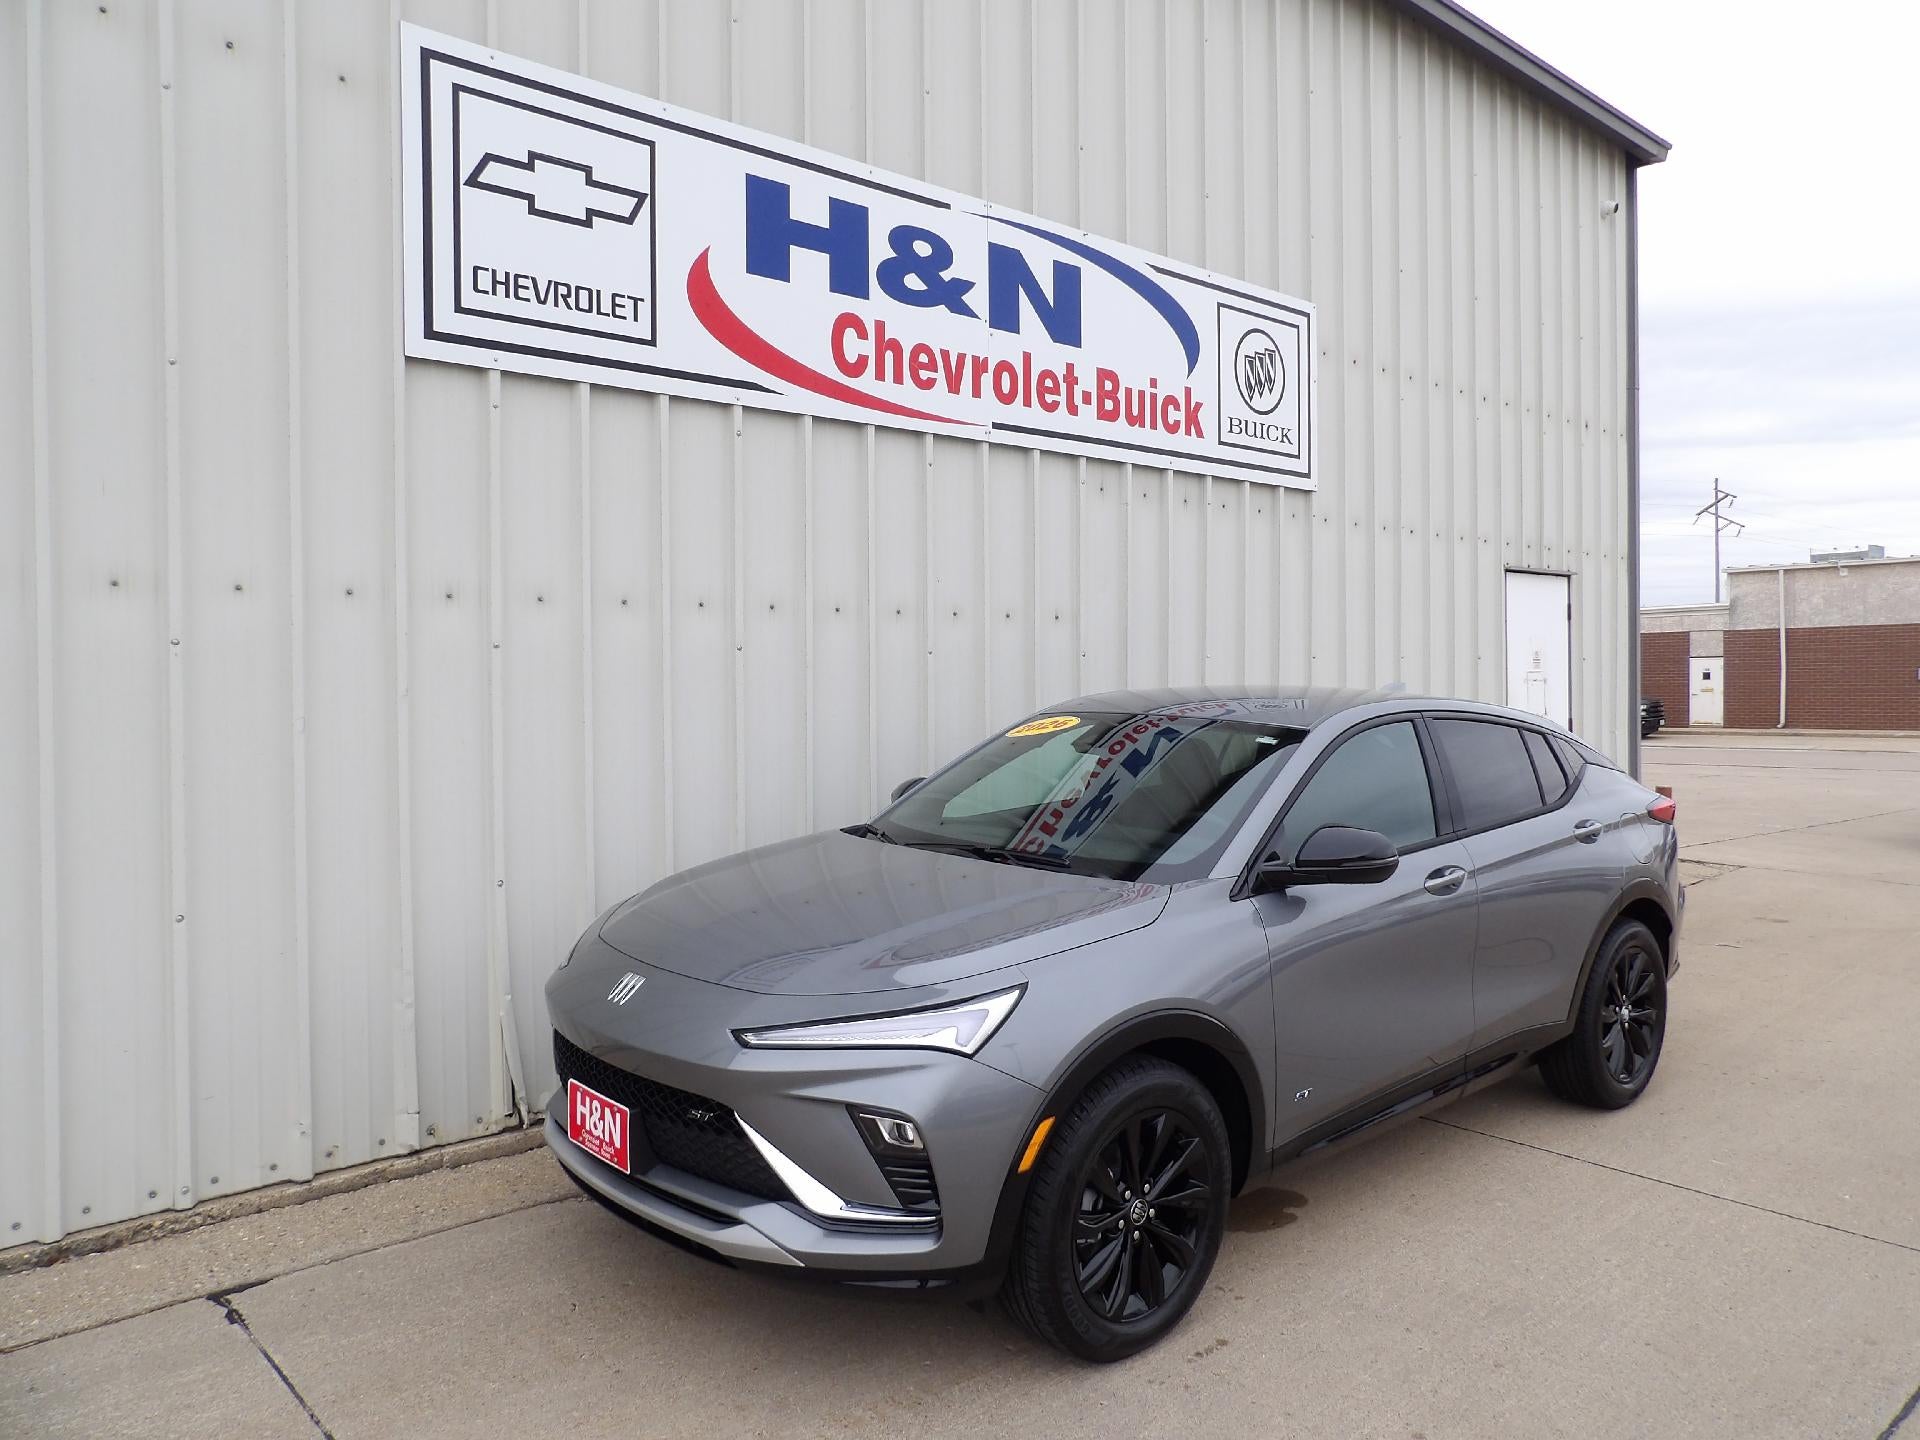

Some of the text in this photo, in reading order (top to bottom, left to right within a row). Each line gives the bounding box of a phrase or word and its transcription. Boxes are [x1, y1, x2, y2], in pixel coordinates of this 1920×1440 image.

[746, 174, 1081, 347] H&N
[472, 265, 645, 323] CHEVROLET
[831, 311, 1204, 439] Chevrolet-Buick
[1227, 416, 1294, 446] BUICK
[576, 1090, 620, 1149] H&N
